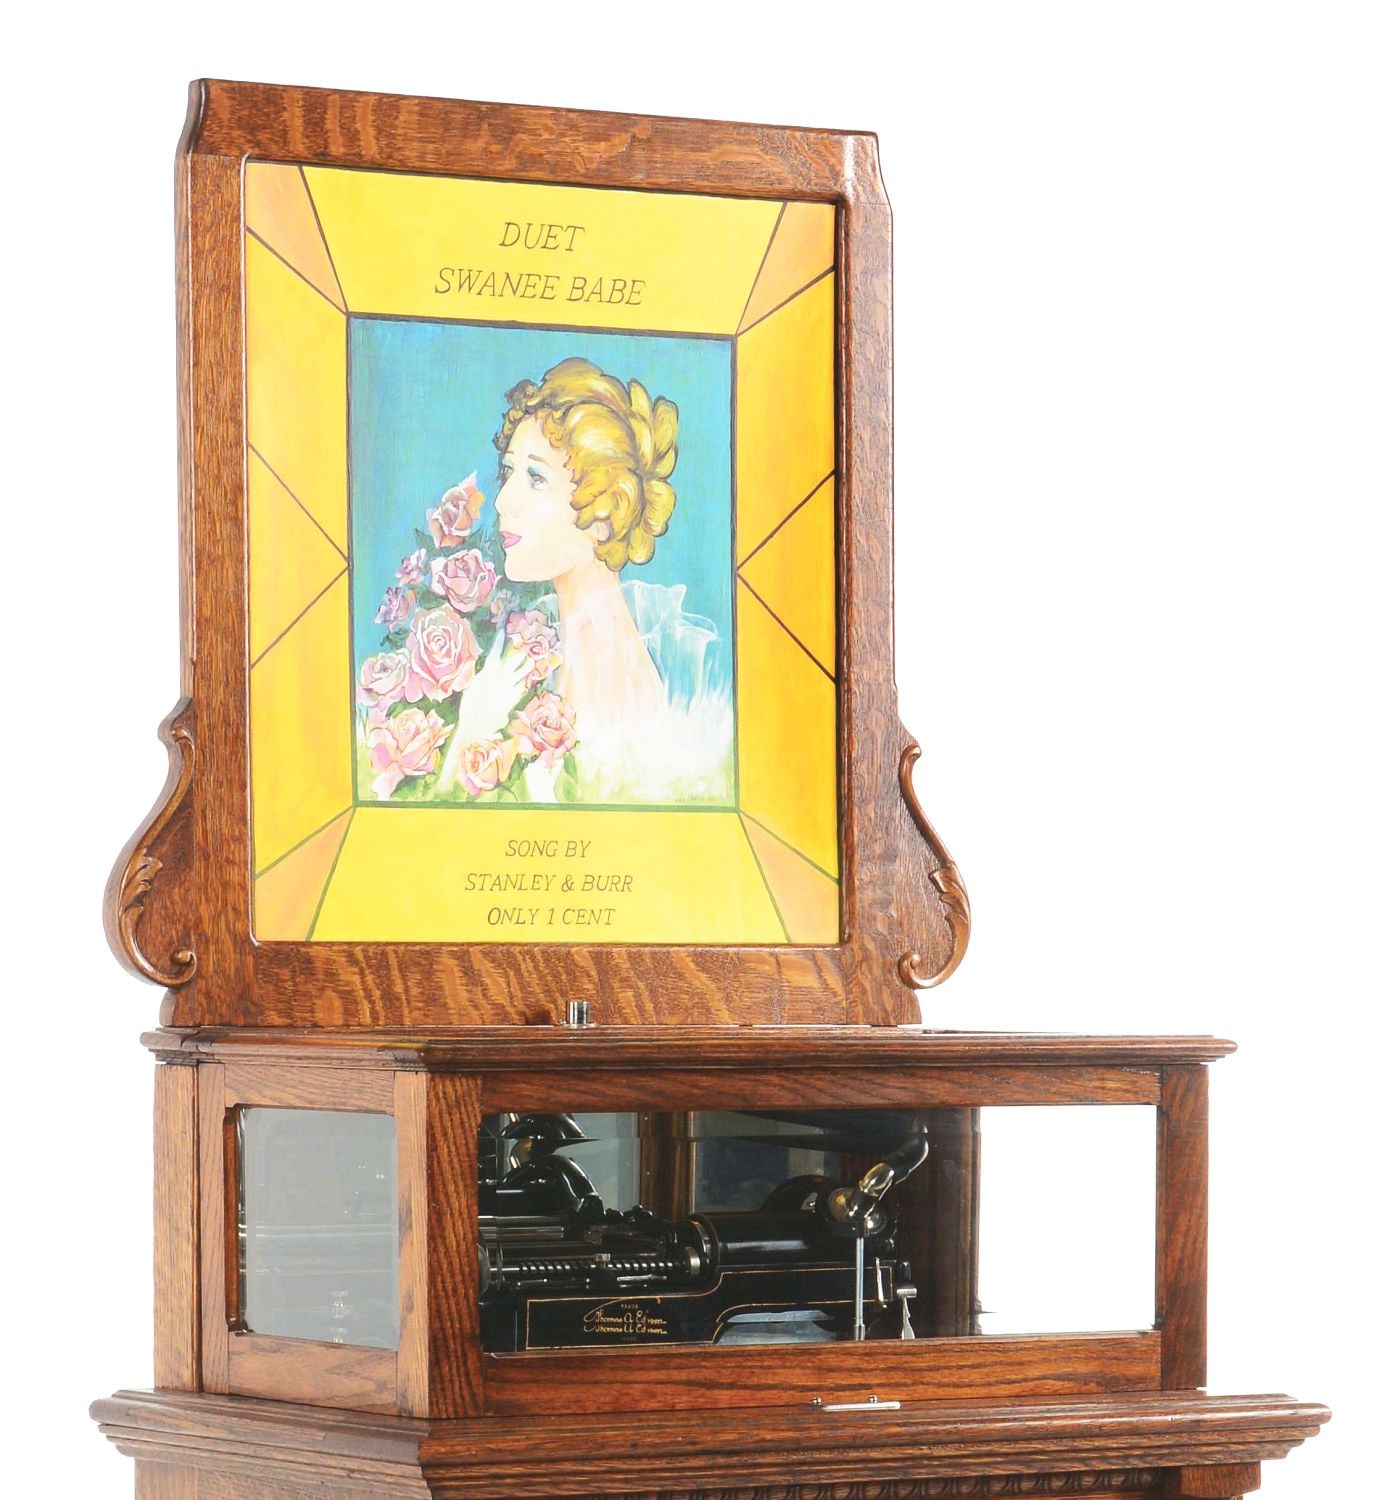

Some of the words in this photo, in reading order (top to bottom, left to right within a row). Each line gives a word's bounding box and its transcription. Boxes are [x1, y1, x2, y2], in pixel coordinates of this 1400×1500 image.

[499, 222, 585, 252] DUET
[435, 268, 560, 300] SWANEE
[566, 277, 645, 305] BABE
[506, 840, 558, 857] SONG
[565, 840, 591, 857] BY
[465, 873, 556, 891] STANLEY
[561, 875, 574, 892] &
[581, 875, 633, 892] BURR
[488, 907, 539, 925] ONLY
[547, 908, 554, 924] 1
[563, 908, 615, 925] CENT
